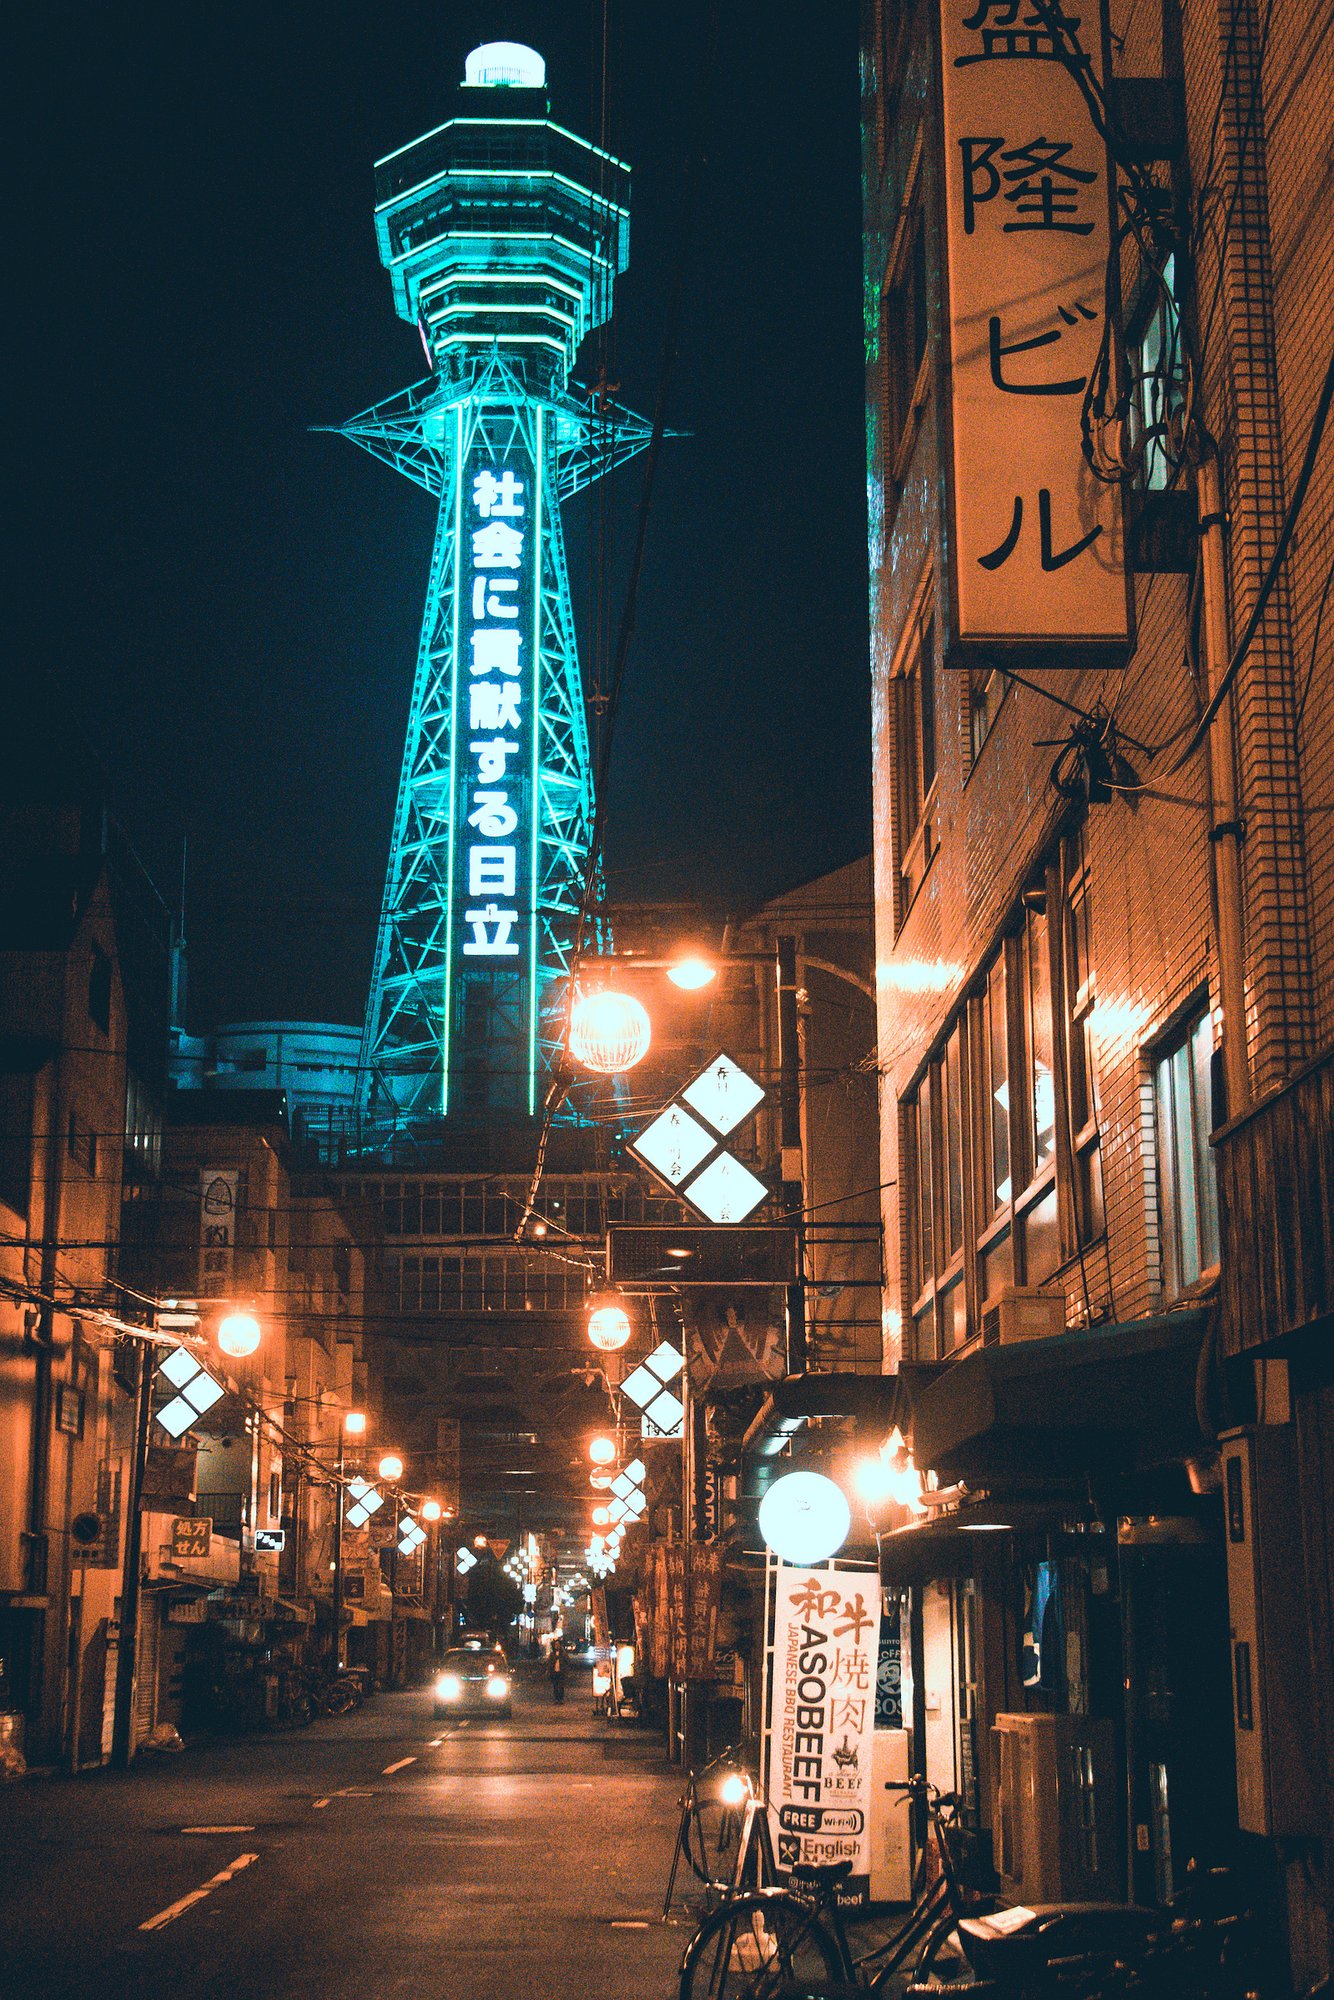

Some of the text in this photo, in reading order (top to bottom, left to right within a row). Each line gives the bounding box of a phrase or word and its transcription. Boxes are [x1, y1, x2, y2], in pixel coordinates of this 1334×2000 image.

[462, 470, 525, 955] 社会に貢献する日立
[175, 1540, 206, 1556] せん
[176, 1520, 208, 1537] 処方
[789, 1577, 874, 1645] 和牛
[781, 1622, 799, 1800] JAPANESE BBQ RESTAURANT
[793, 1624, 828, 1802] ASOBEEF
[828, 1648, 870, 1735] 焼肉
[824, 1777, 863, 1790] BEEF
[783, 1810, 816, 1829] FREE
[804, 1838, 861, 1859] English
